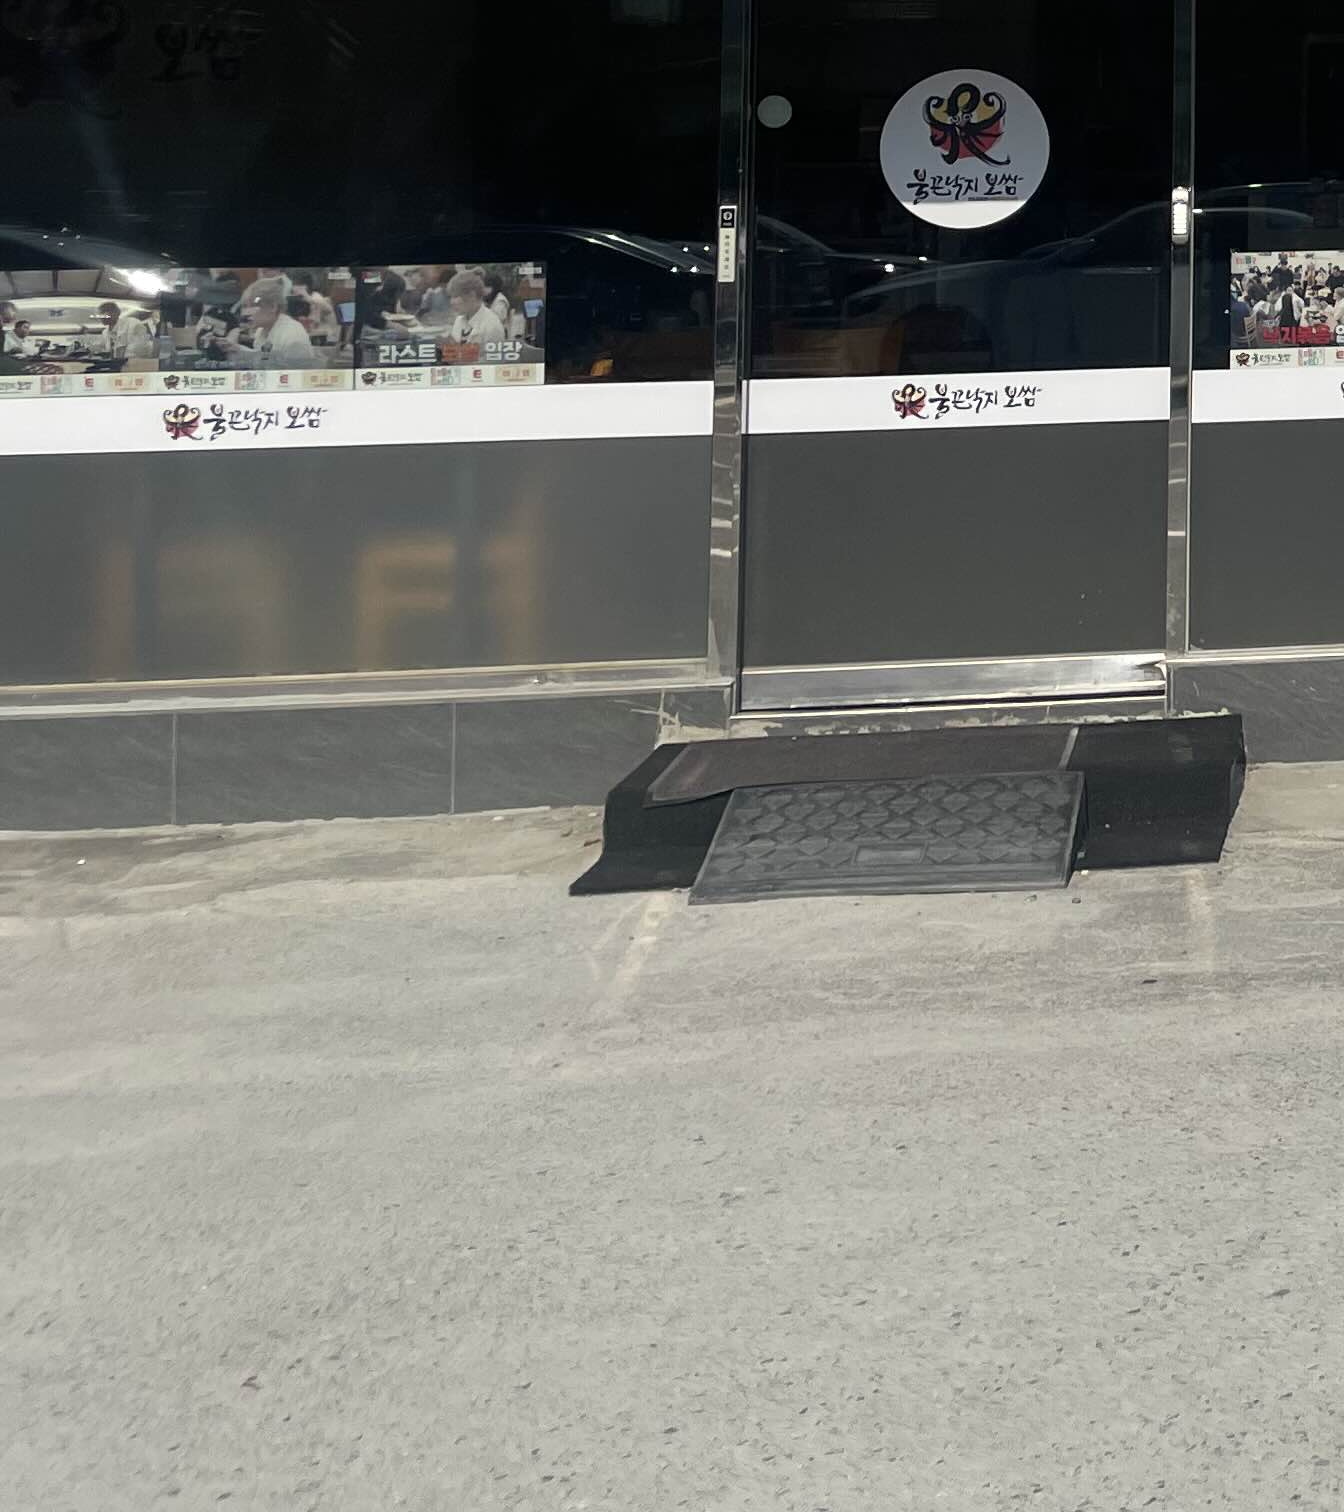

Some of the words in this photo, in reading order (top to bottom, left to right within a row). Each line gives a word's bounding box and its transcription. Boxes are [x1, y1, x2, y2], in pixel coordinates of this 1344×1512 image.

[907, 168, 979, 205] 불끈낙지
[984, 173, 1024, 196] 보쌈
[378, 343, 437, 364] 라스트
[485, 341, 523, 361] 입장
[928, 383, 998, 420] 불끈낙지
[1003, 385, 1042, 408] 보쌈
[203, 403, 279, 442] 불끈낙지
[285, 405, 328, 429] 보쌈
